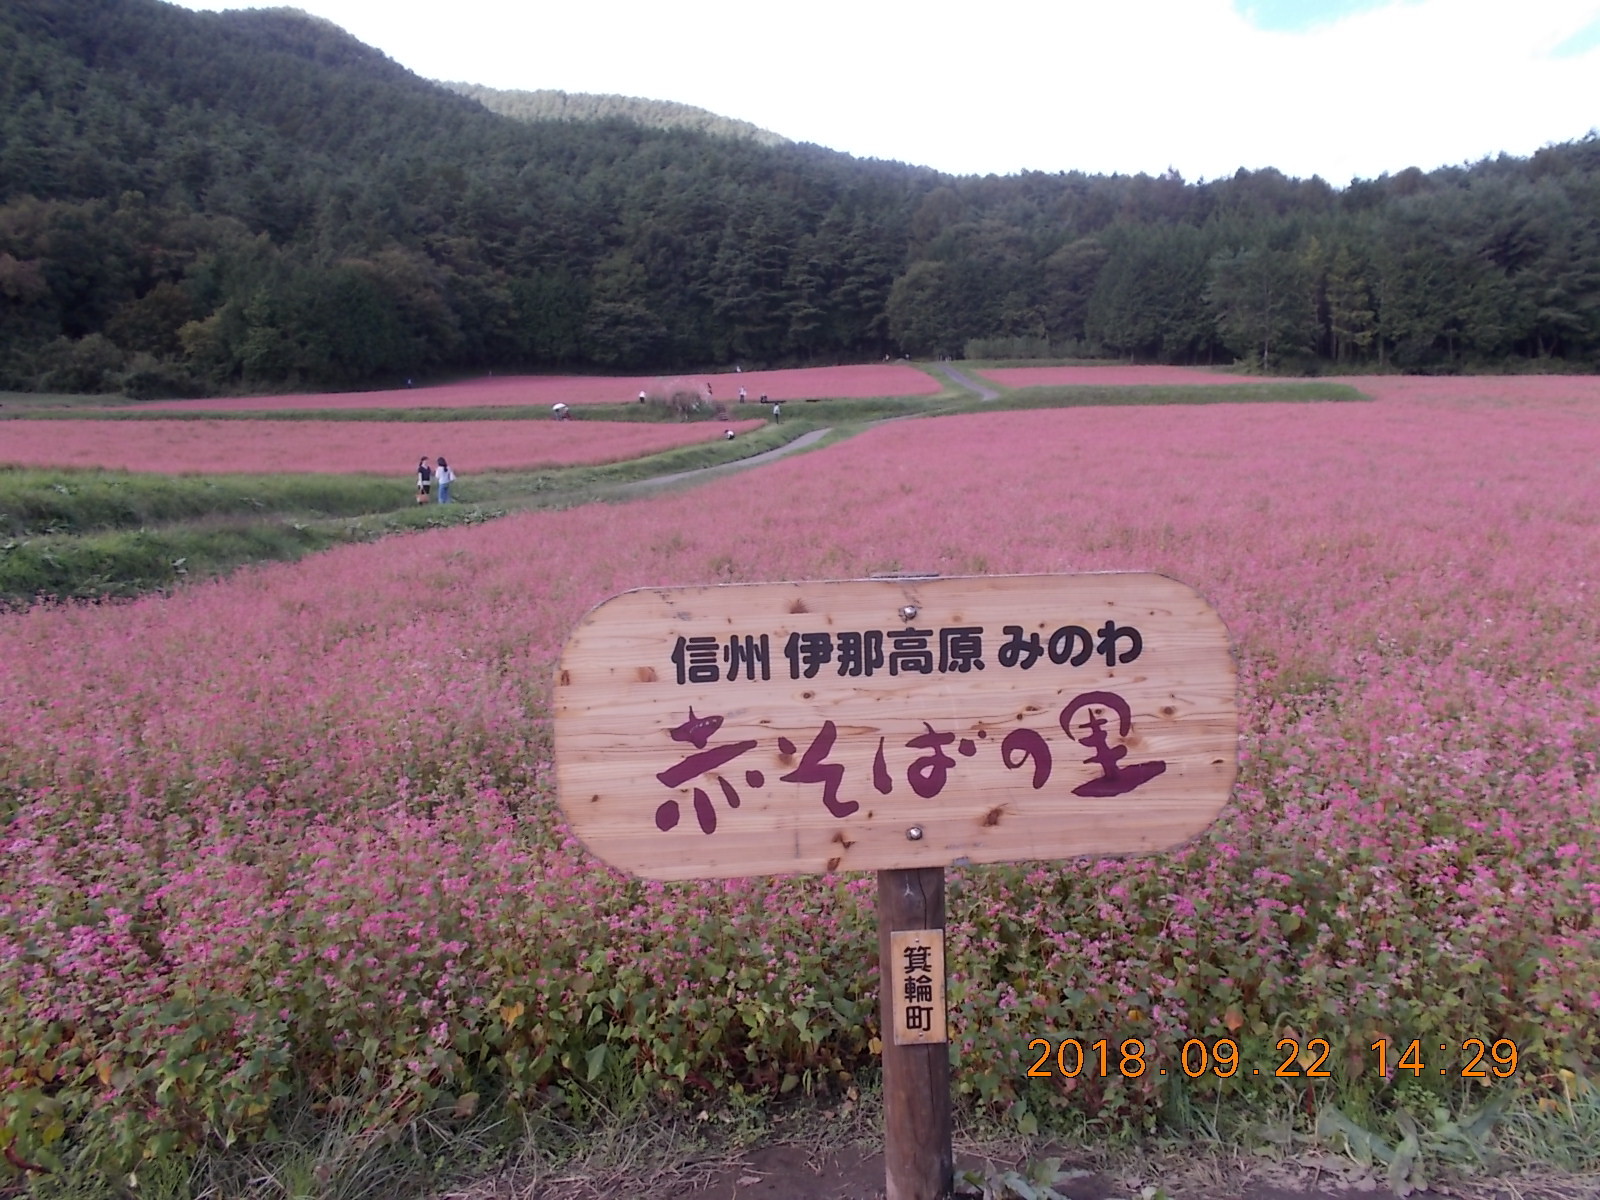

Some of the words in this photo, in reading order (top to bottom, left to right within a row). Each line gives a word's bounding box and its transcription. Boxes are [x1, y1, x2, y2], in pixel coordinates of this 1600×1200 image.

[671, 634, 771, 685] 信州
[784, 625, 985, 679] 伊那高原
[998, 620, 1143, 670] みのわ
[655, 691, 1166, 834] 赤そばの里
[903, 945, 933, 1032] 箕輪町
